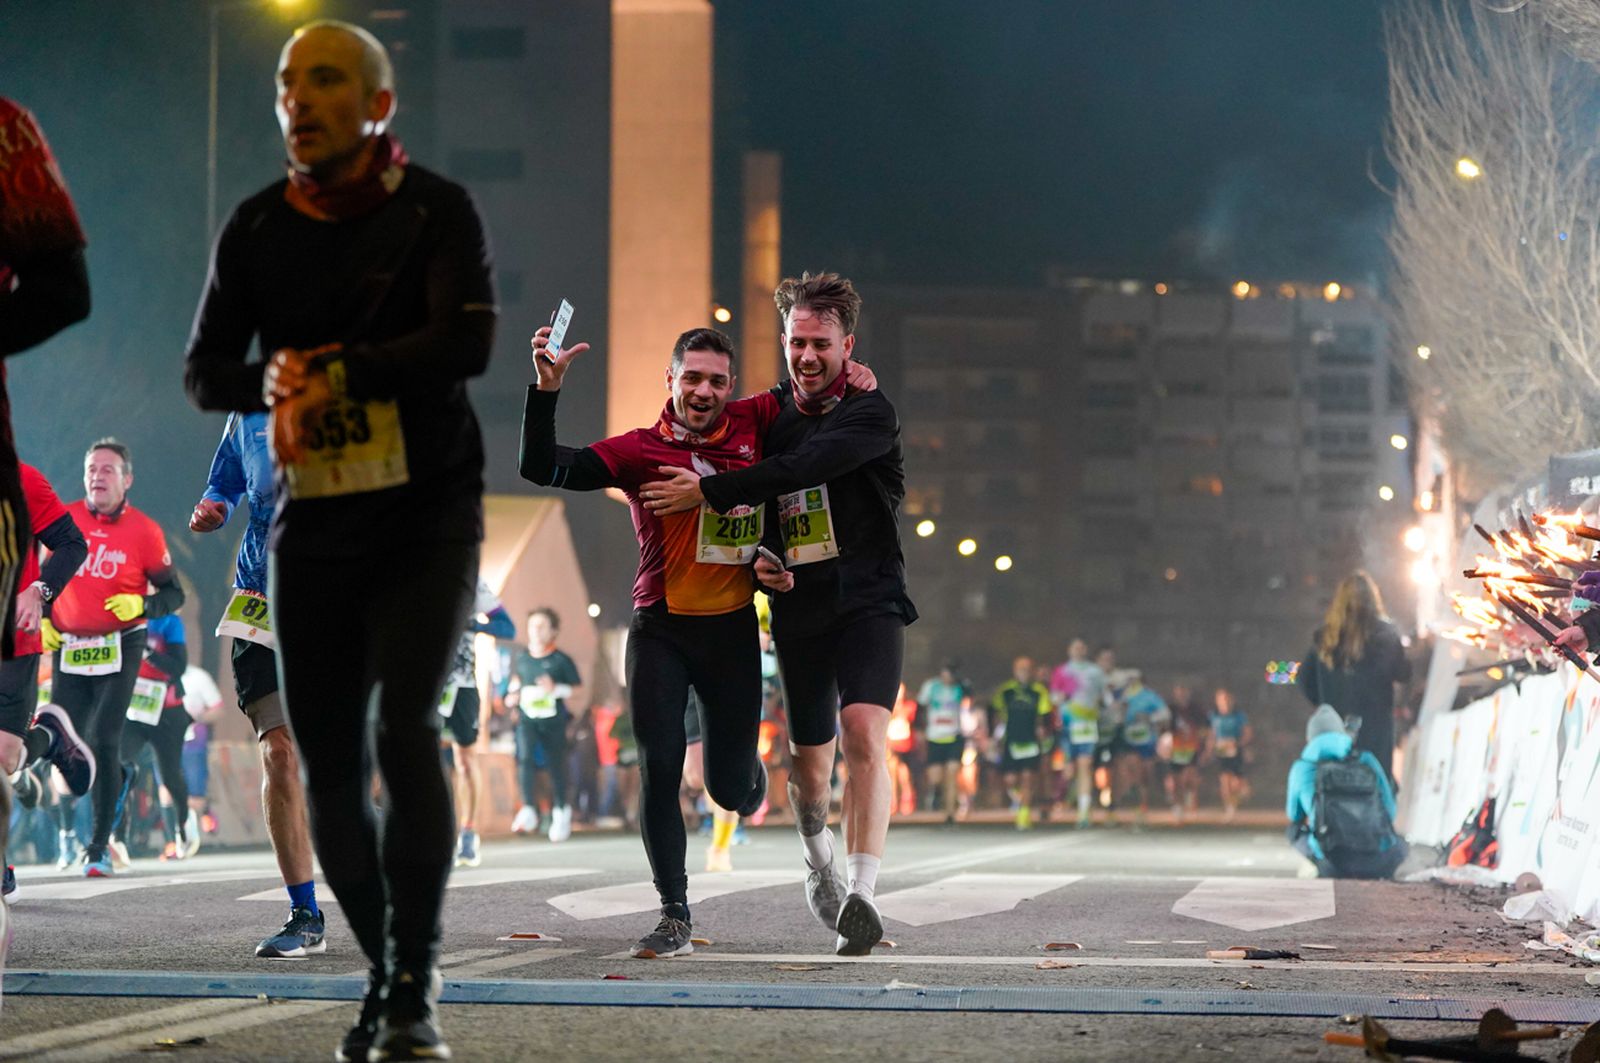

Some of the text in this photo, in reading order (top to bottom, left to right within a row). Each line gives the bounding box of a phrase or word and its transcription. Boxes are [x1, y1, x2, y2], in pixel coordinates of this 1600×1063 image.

[716, 514, 757, 539] 2879
[242, 598, 269, 624] 87
[73, 646, 110, 662] 6529
